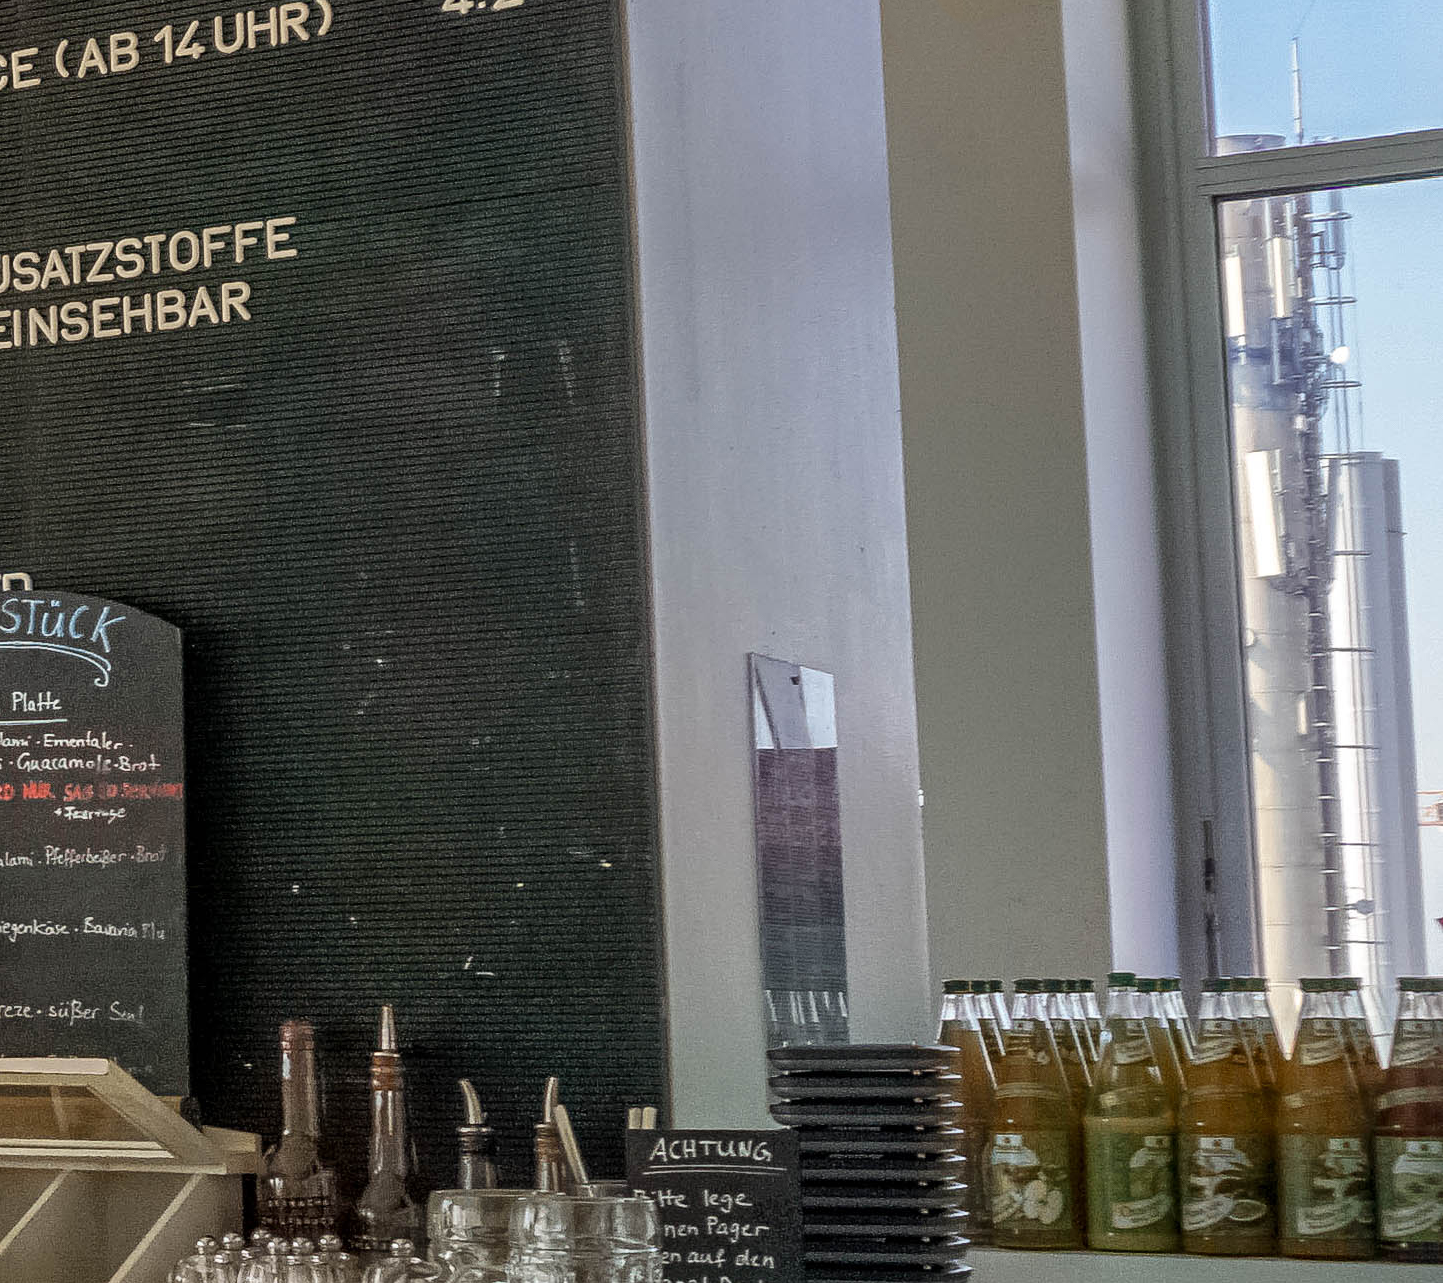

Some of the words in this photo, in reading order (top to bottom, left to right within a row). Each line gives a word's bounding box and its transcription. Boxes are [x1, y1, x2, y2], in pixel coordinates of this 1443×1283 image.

[54, 31, 140, 79] (AB
[152, 19, 206, 65] 14
[12, 691, 62, 712] Platte
[17, 752, 111, 772] Guacamole
[119, 753, 161, 772] Brot
[650, 1137, 772, 1162] ACHTUNG
[704, 1189, 753, 1213] lege
[707, 1216, 770, 1244] Pager
[688, 1249, 727, 1268] auf
[735, 1249, 775, 1269] den
